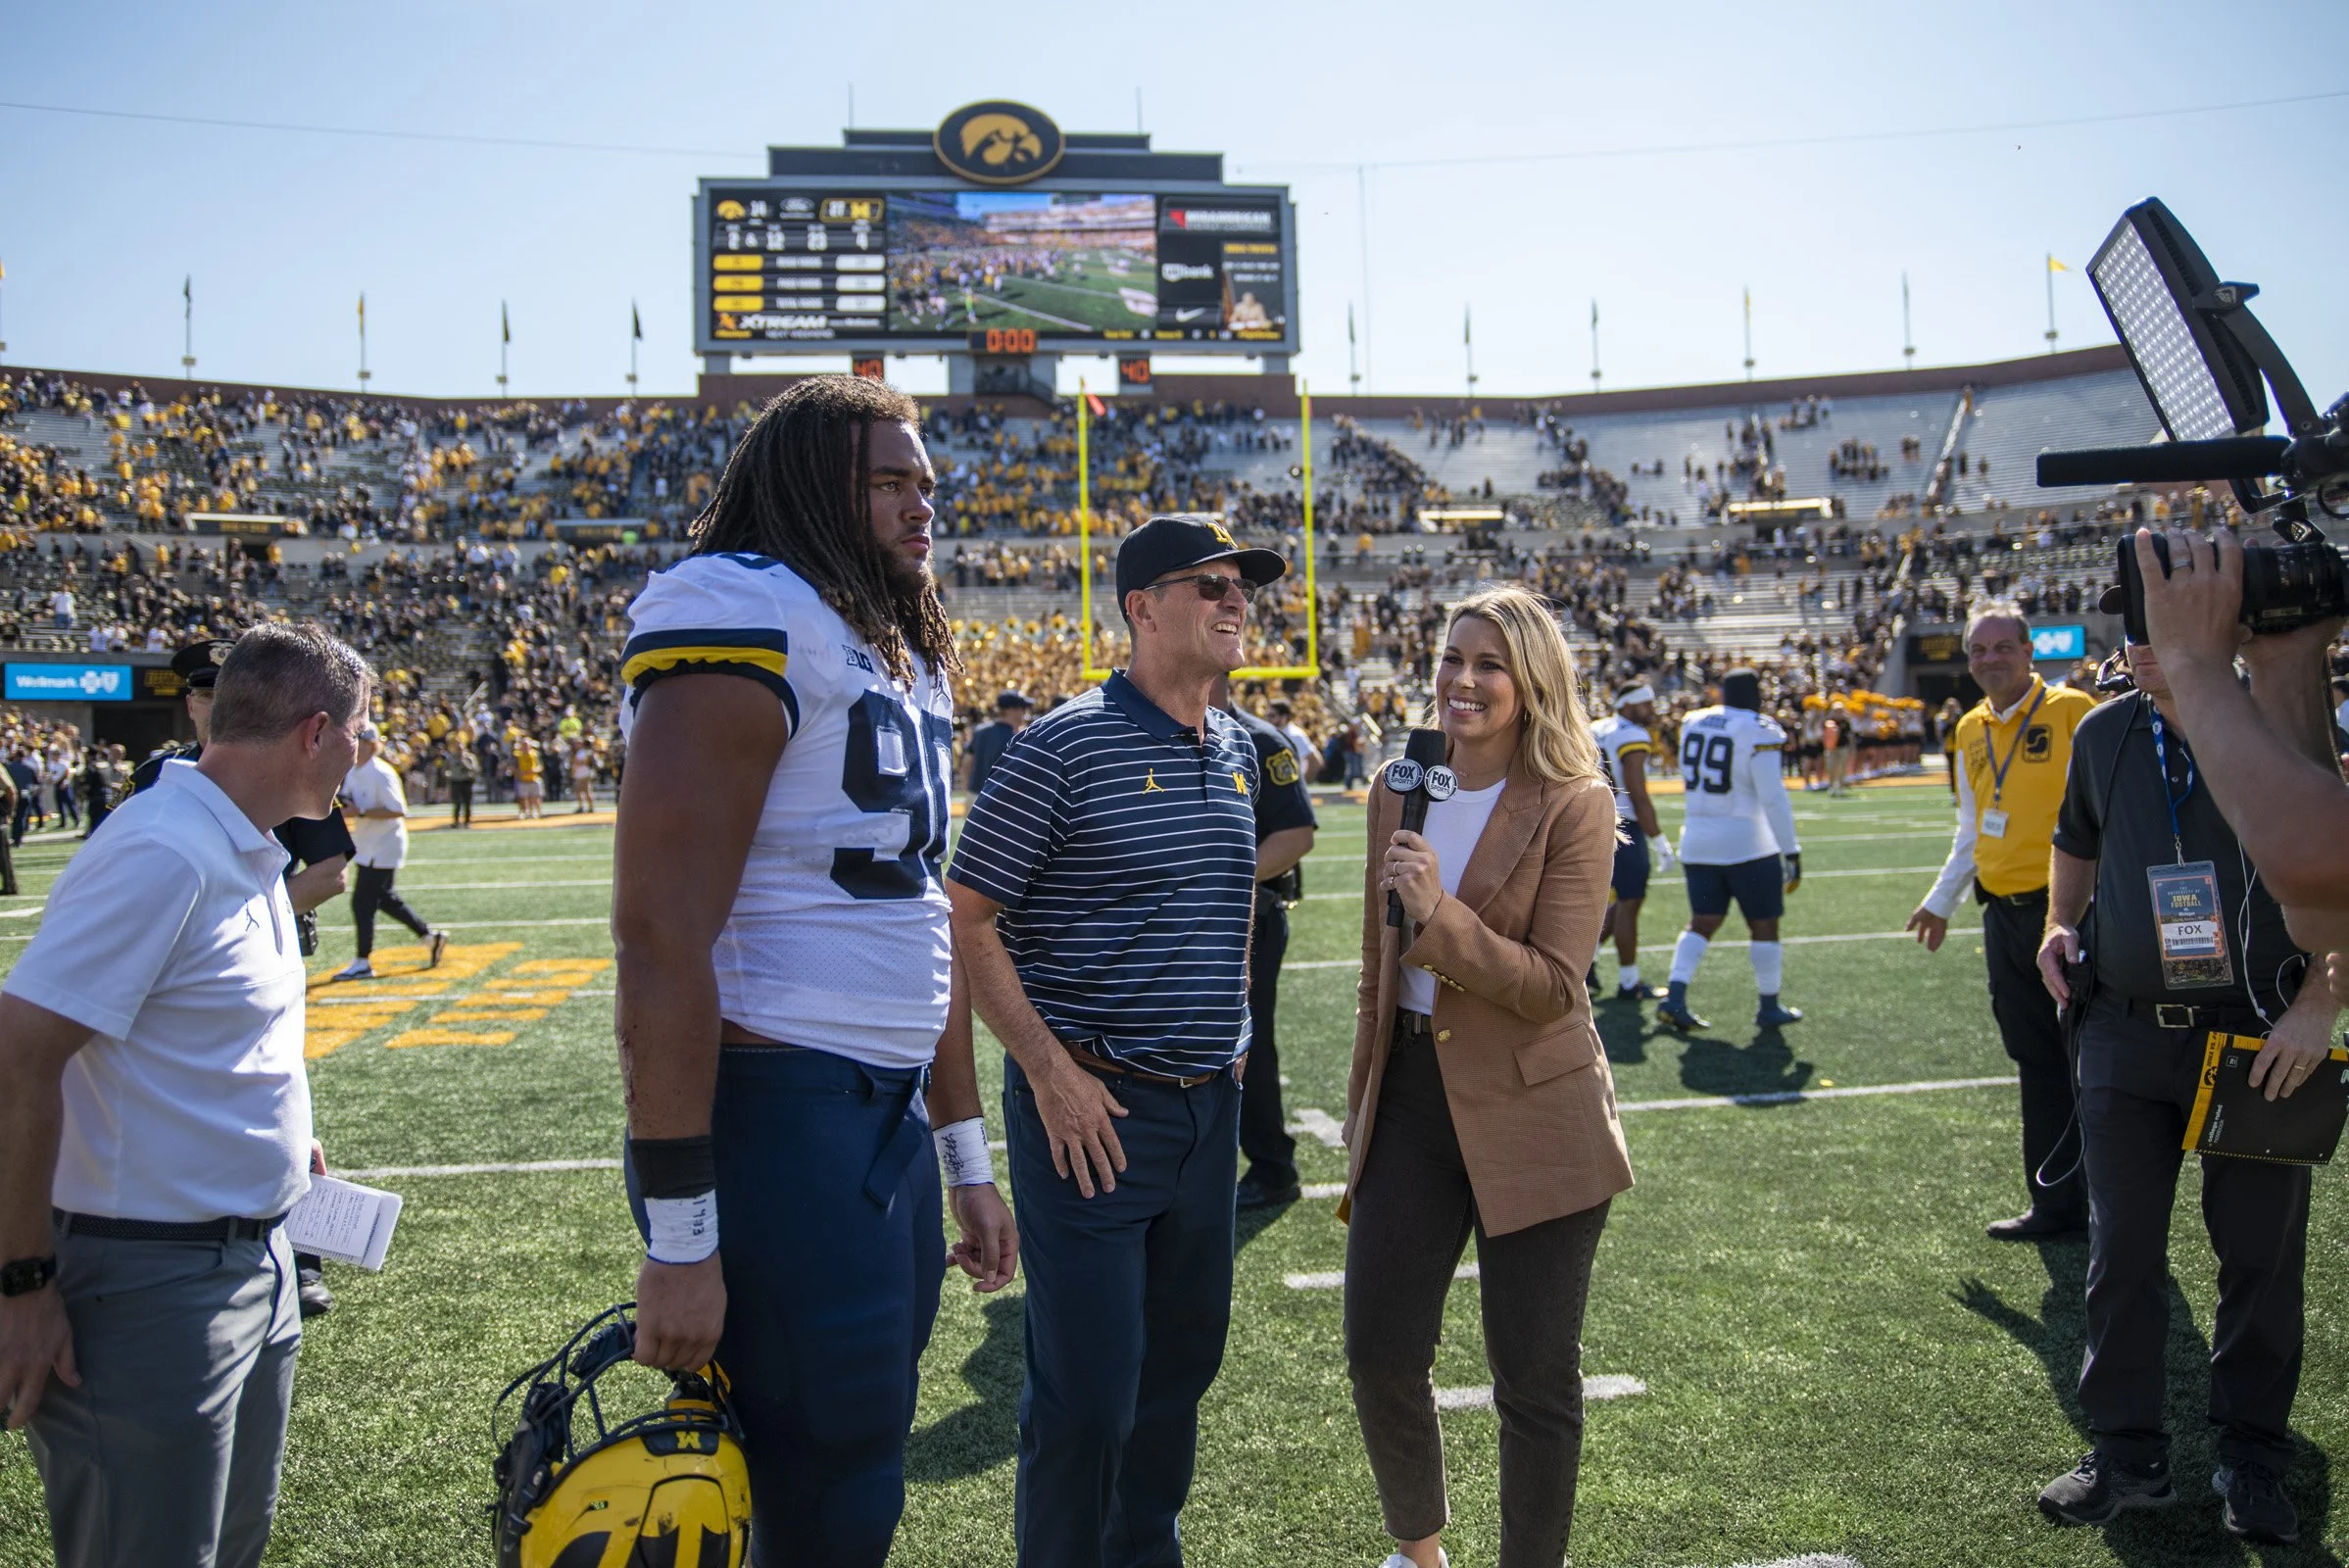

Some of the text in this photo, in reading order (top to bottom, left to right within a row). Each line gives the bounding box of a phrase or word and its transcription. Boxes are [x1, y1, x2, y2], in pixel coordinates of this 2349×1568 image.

[986, 328, 1036, 353] 0:00
[1121, 360, 1150, 383] 40
[1393, 764, 1416, 780] FOX
[1684, 732, 1733, 795] 99
[1432, 771, 1452, 789] FOX
[1431, 783, 1450, 795] SPORTS
[2171, 900, 2202, 908] FOOTBALL
[2178, 924, 2202, 936] FOX
